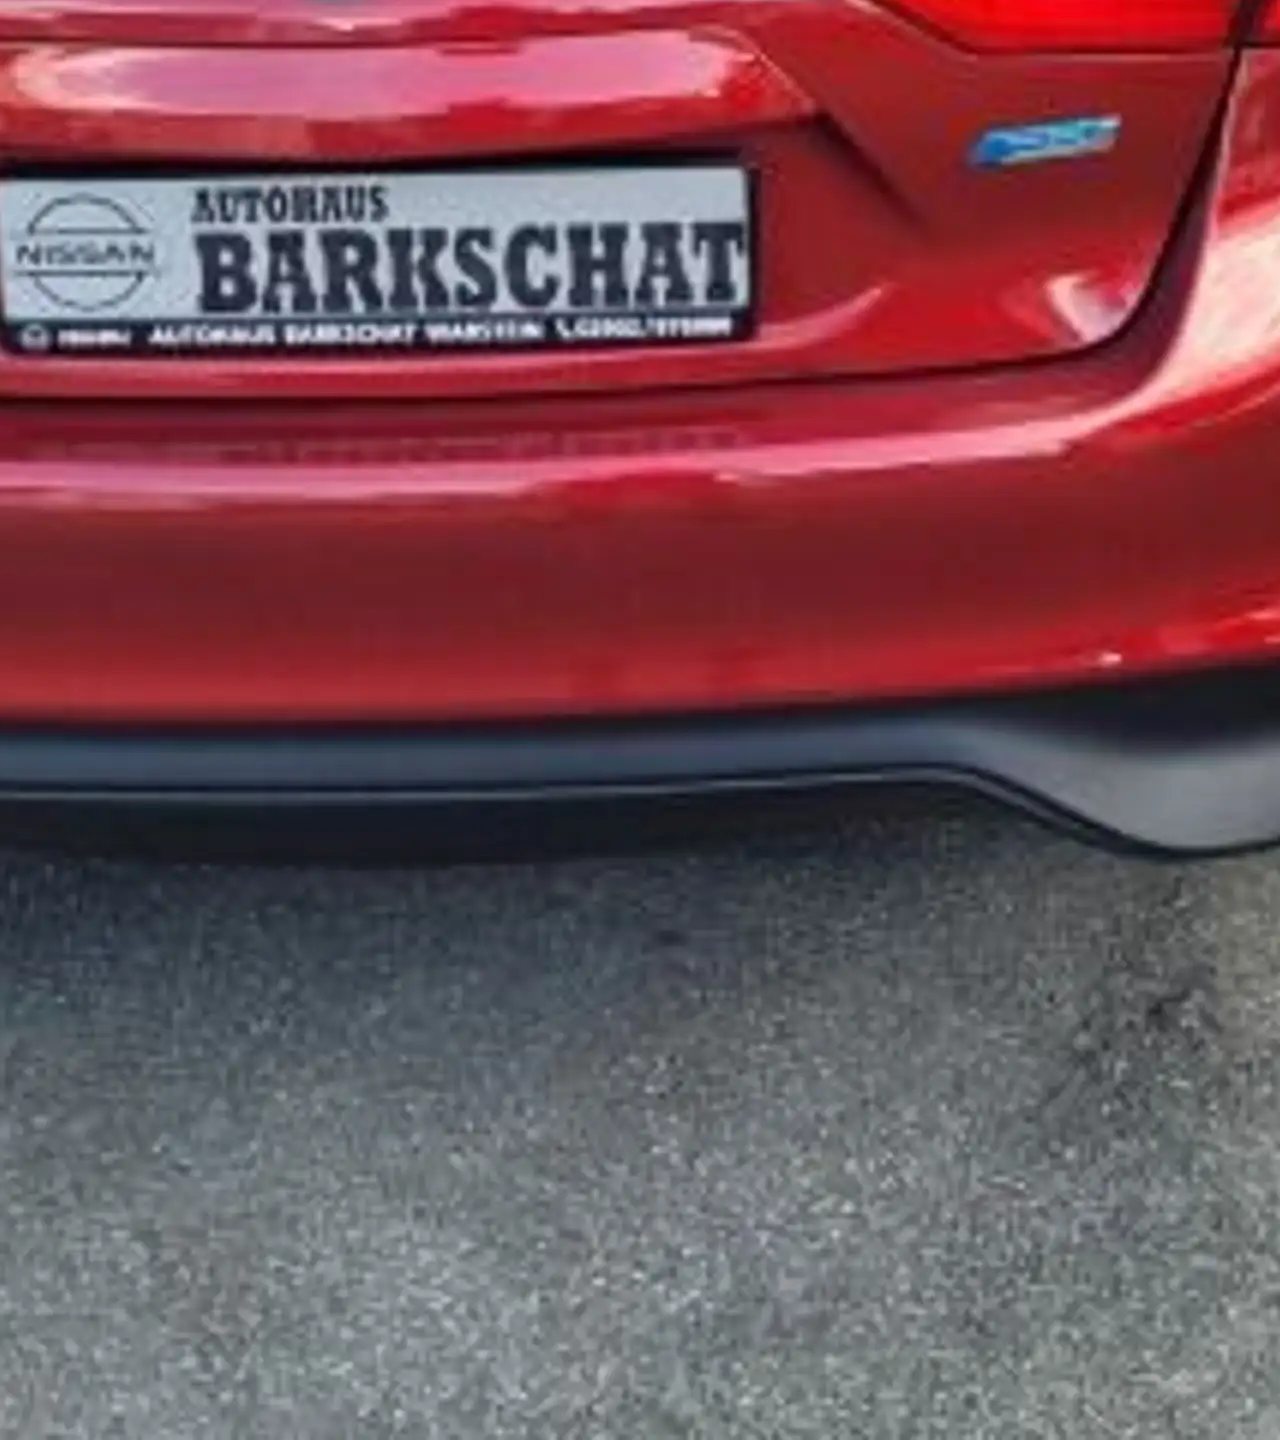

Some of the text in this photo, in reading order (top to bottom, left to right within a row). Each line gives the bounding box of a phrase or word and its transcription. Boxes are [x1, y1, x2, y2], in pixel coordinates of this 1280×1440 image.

[191, 185, 389, 225] AUTOHAUS
[15, 242, 156, 268] NISSAN
[194, 222, 745, 314] BARKSCHAT
